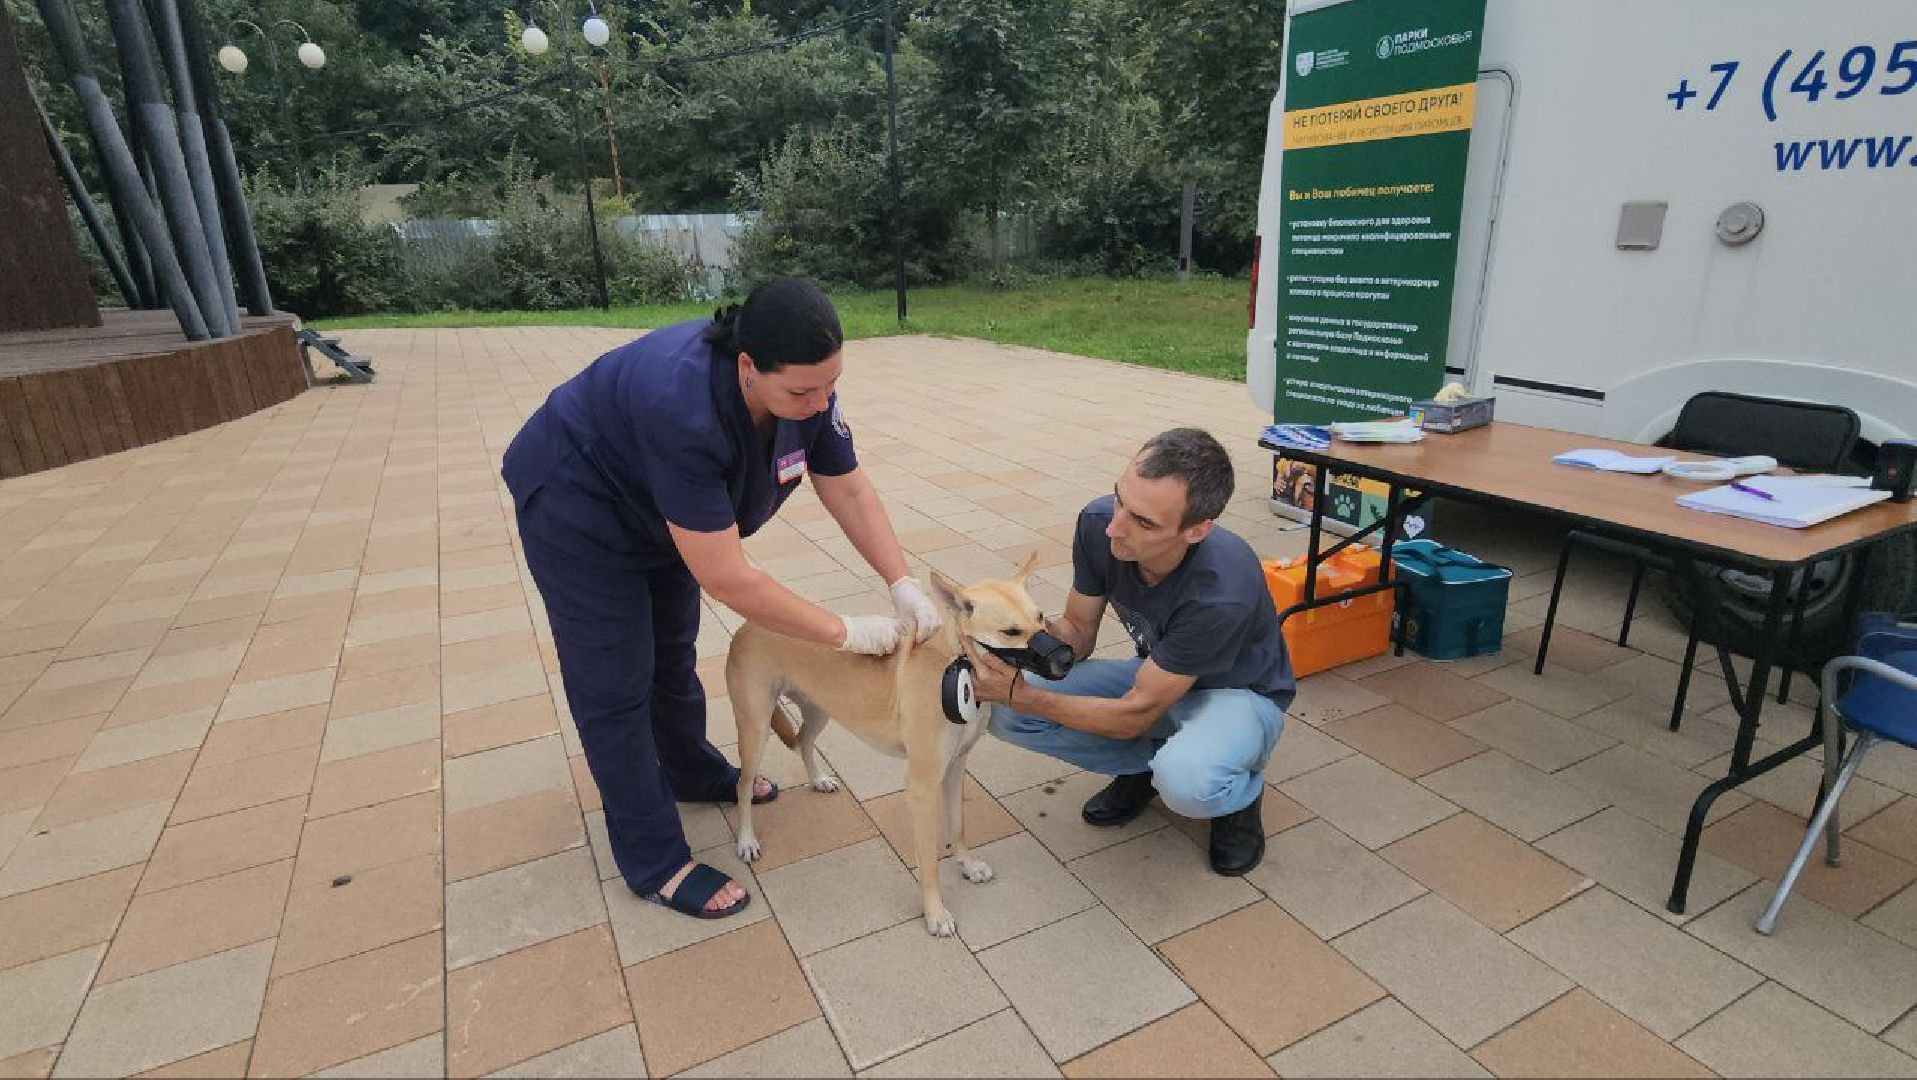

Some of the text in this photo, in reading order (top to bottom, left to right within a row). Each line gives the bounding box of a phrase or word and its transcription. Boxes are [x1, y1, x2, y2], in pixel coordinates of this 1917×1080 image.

[1394, 28, 1428, 44] ПАРКИ
[1395, 30, 1473, 56] ПОДМОСКОВЬЯ
[1667, 40, 1917, 122] +7 (495
[1293, 91, 1464, 128] НЕ ПОТЕРЯЙ СВОЕГО ДРУГА!
